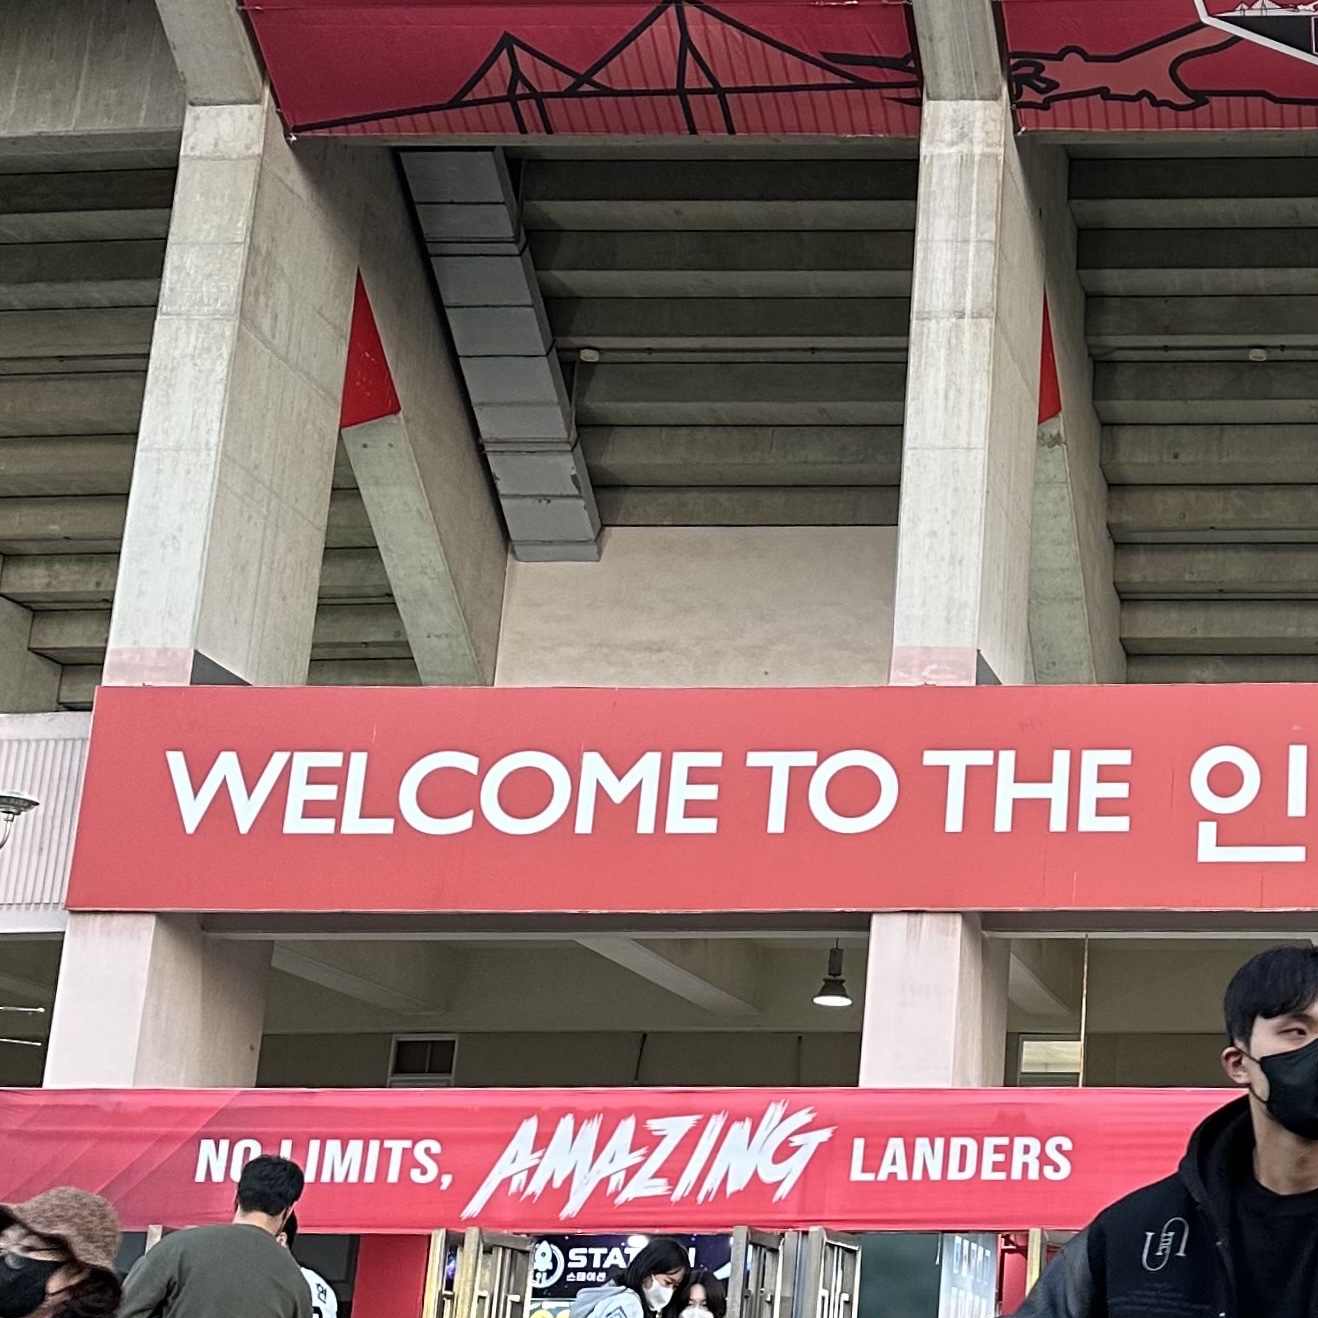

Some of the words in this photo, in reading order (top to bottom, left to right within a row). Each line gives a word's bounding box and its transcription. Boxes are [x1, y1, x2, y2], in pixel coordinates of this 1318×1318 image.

[165, 750, 723, 835] WELCOME
[746, 749, 899, 834] TO
[922, 749, 1132, 833] THE
[280, 1139, 453, 1190] IMITS,
[459, 1099, 839, 1221] AMAZING
[849, 1136, 1073, 1181] LANDERS
